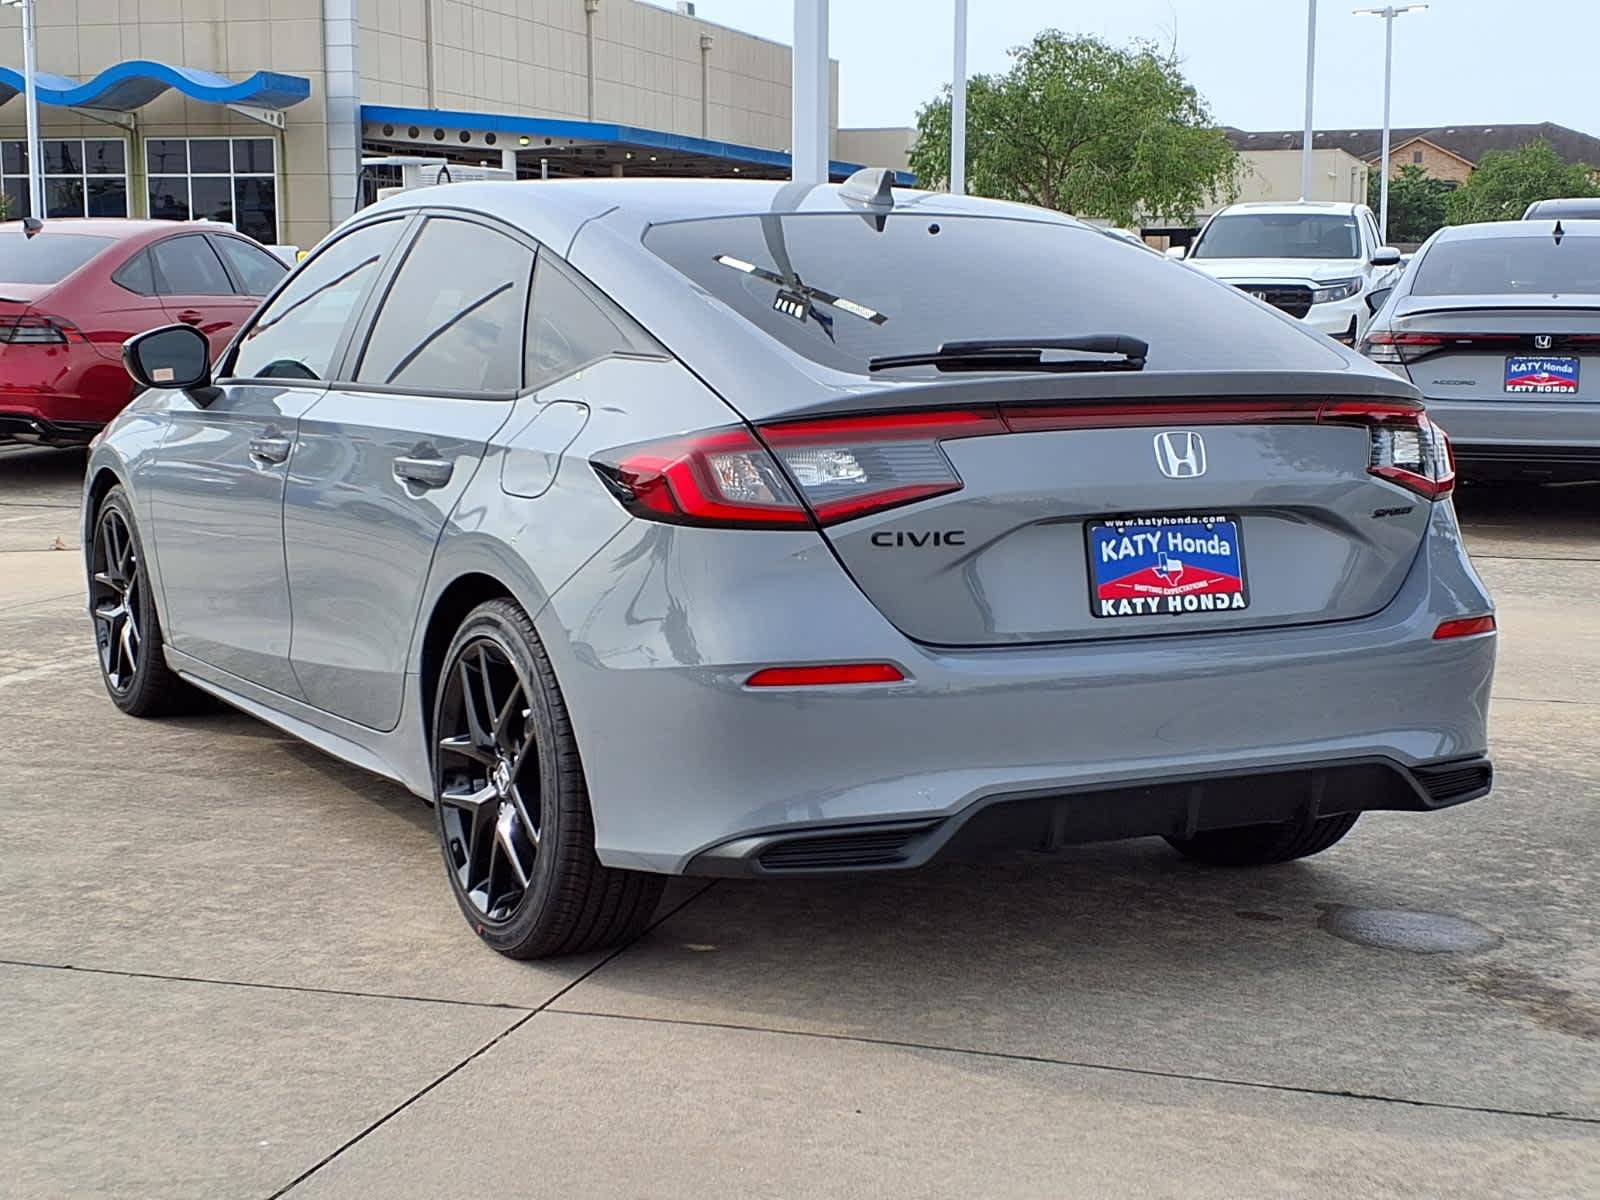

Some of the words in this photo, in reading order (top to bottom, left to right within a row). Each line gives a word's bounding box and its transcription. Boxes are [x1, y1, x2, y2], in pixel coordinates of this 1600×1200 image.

[1511, 362, 1541, 373] KATY
[1543, 362, 1573, 373] Honda
[1506, 385, 1534, 393] KATY
[1537, 385, 1575, 393] HONDA
[1104, 515, 1226, 527] www.katyhonda.com
[871, 530, 965, 547] CIVIC
[1101, 531, 1161, 562] KATY
[1167, 532, 1231, 556] Honda
[1101, 597, 1161, 616] KATY
[1168, 593, 1245, 614] HONDA
